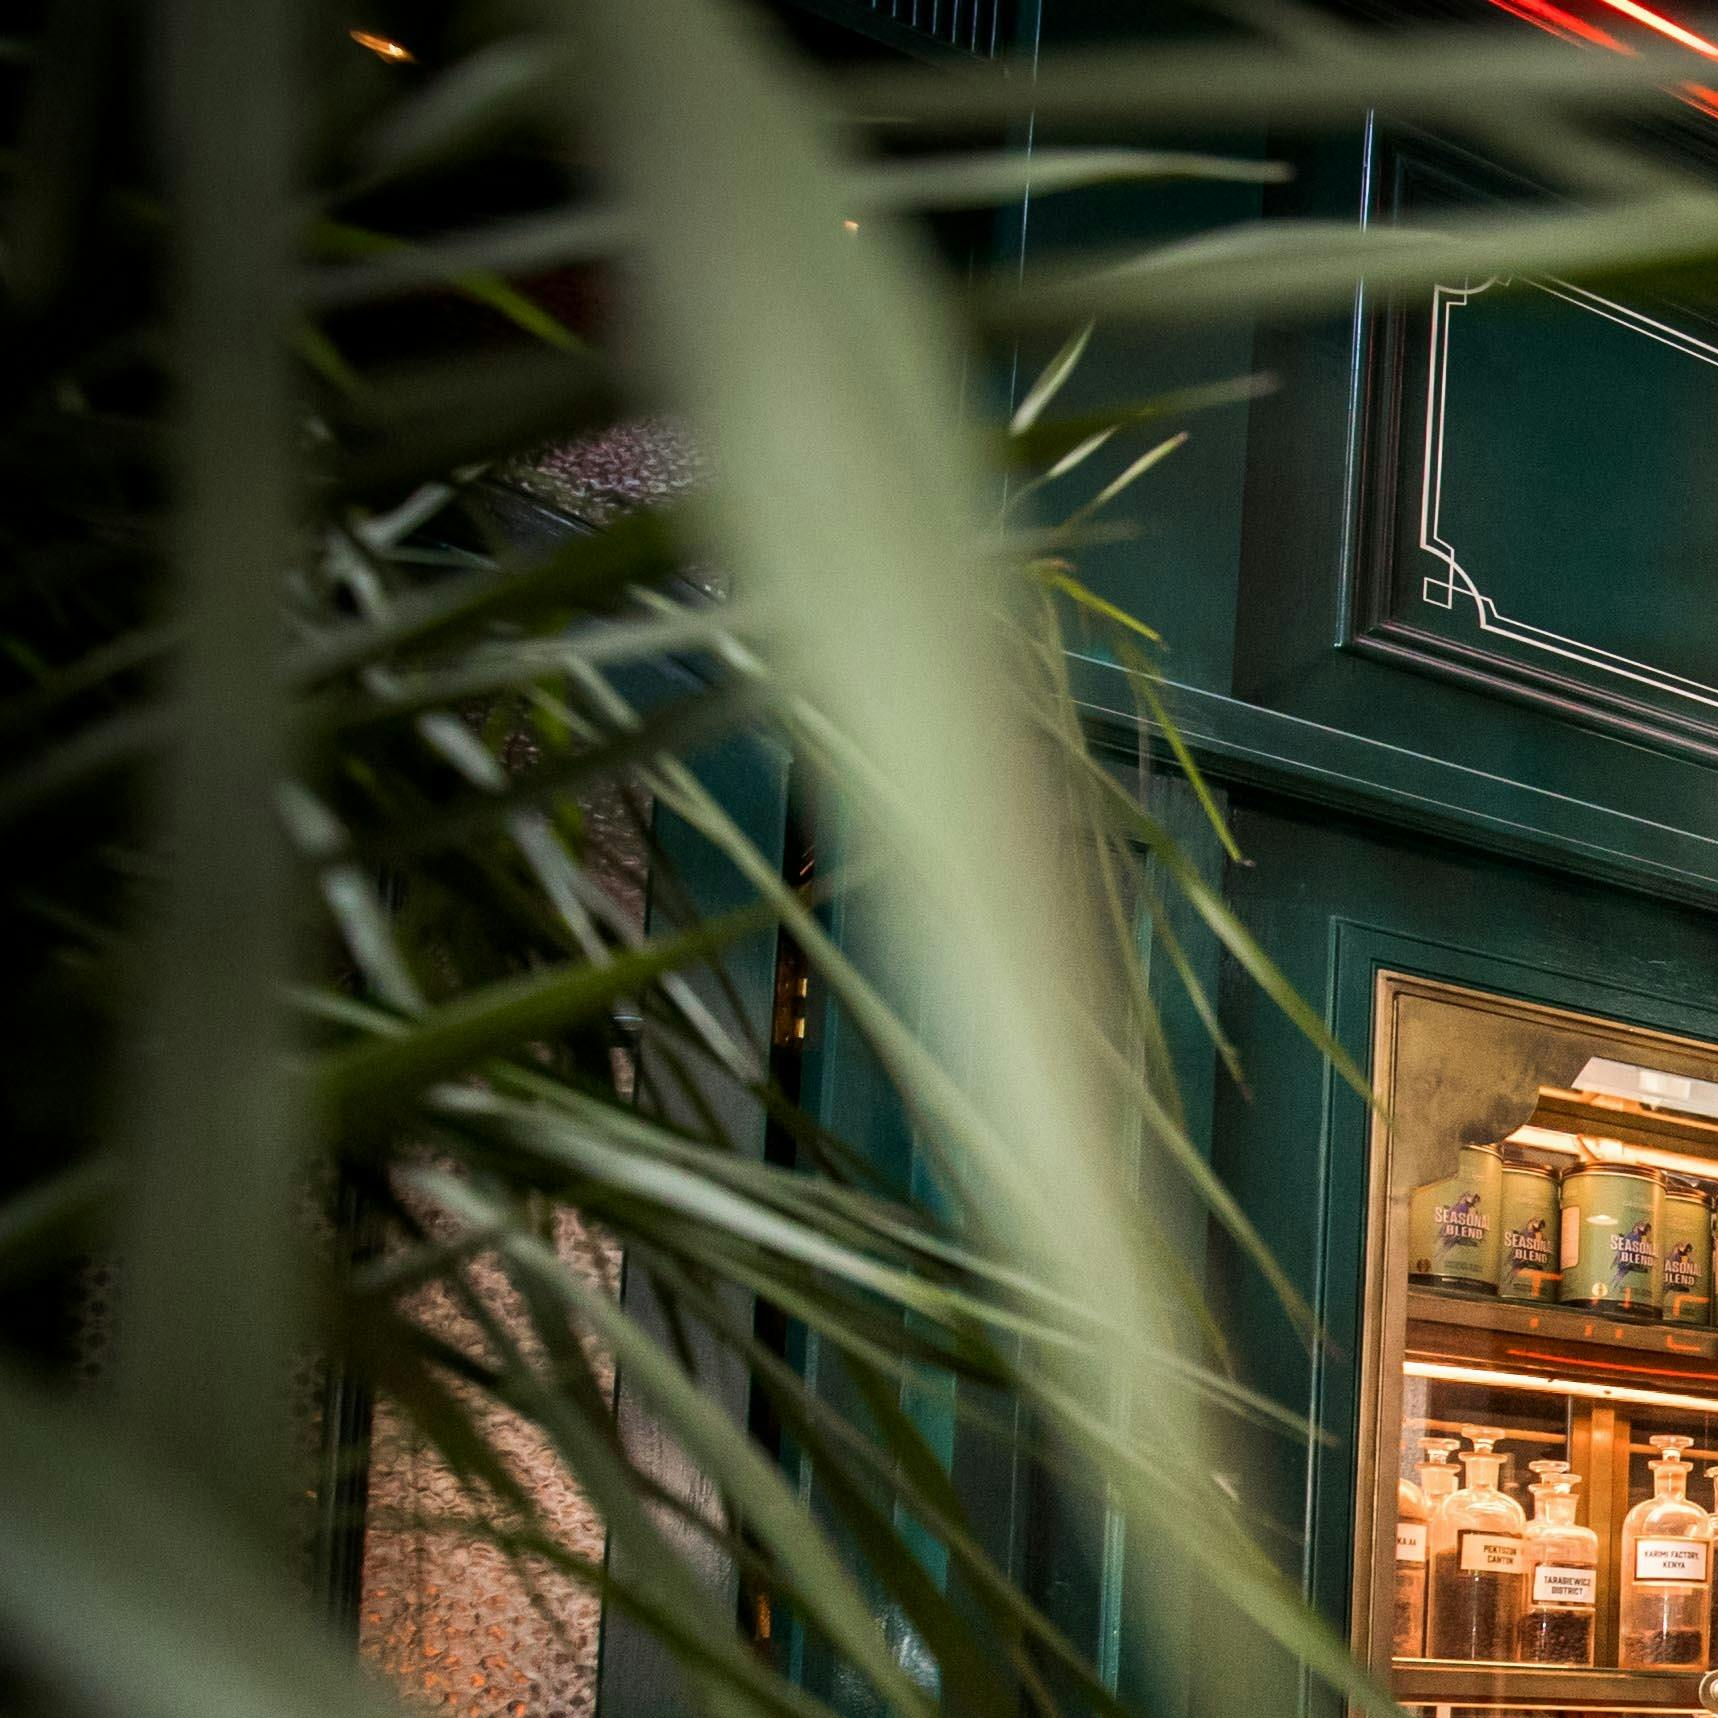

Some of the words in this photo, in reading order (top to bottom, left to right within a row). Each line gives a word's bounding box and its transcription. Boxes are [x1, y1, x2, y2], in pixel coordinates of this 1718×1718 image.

[1446, 1225, 1484, 1240] BLEND
[1504, 1230, 1553, 1254] SEASON
[1610, 1233, 1659, 1258] SEASON
[1514, 1247, 1548, 1264] BLEND
[1621, 1251, 1654, 1268] BLEND
[1551, 1586, 1583, 1595] DISTRICT
